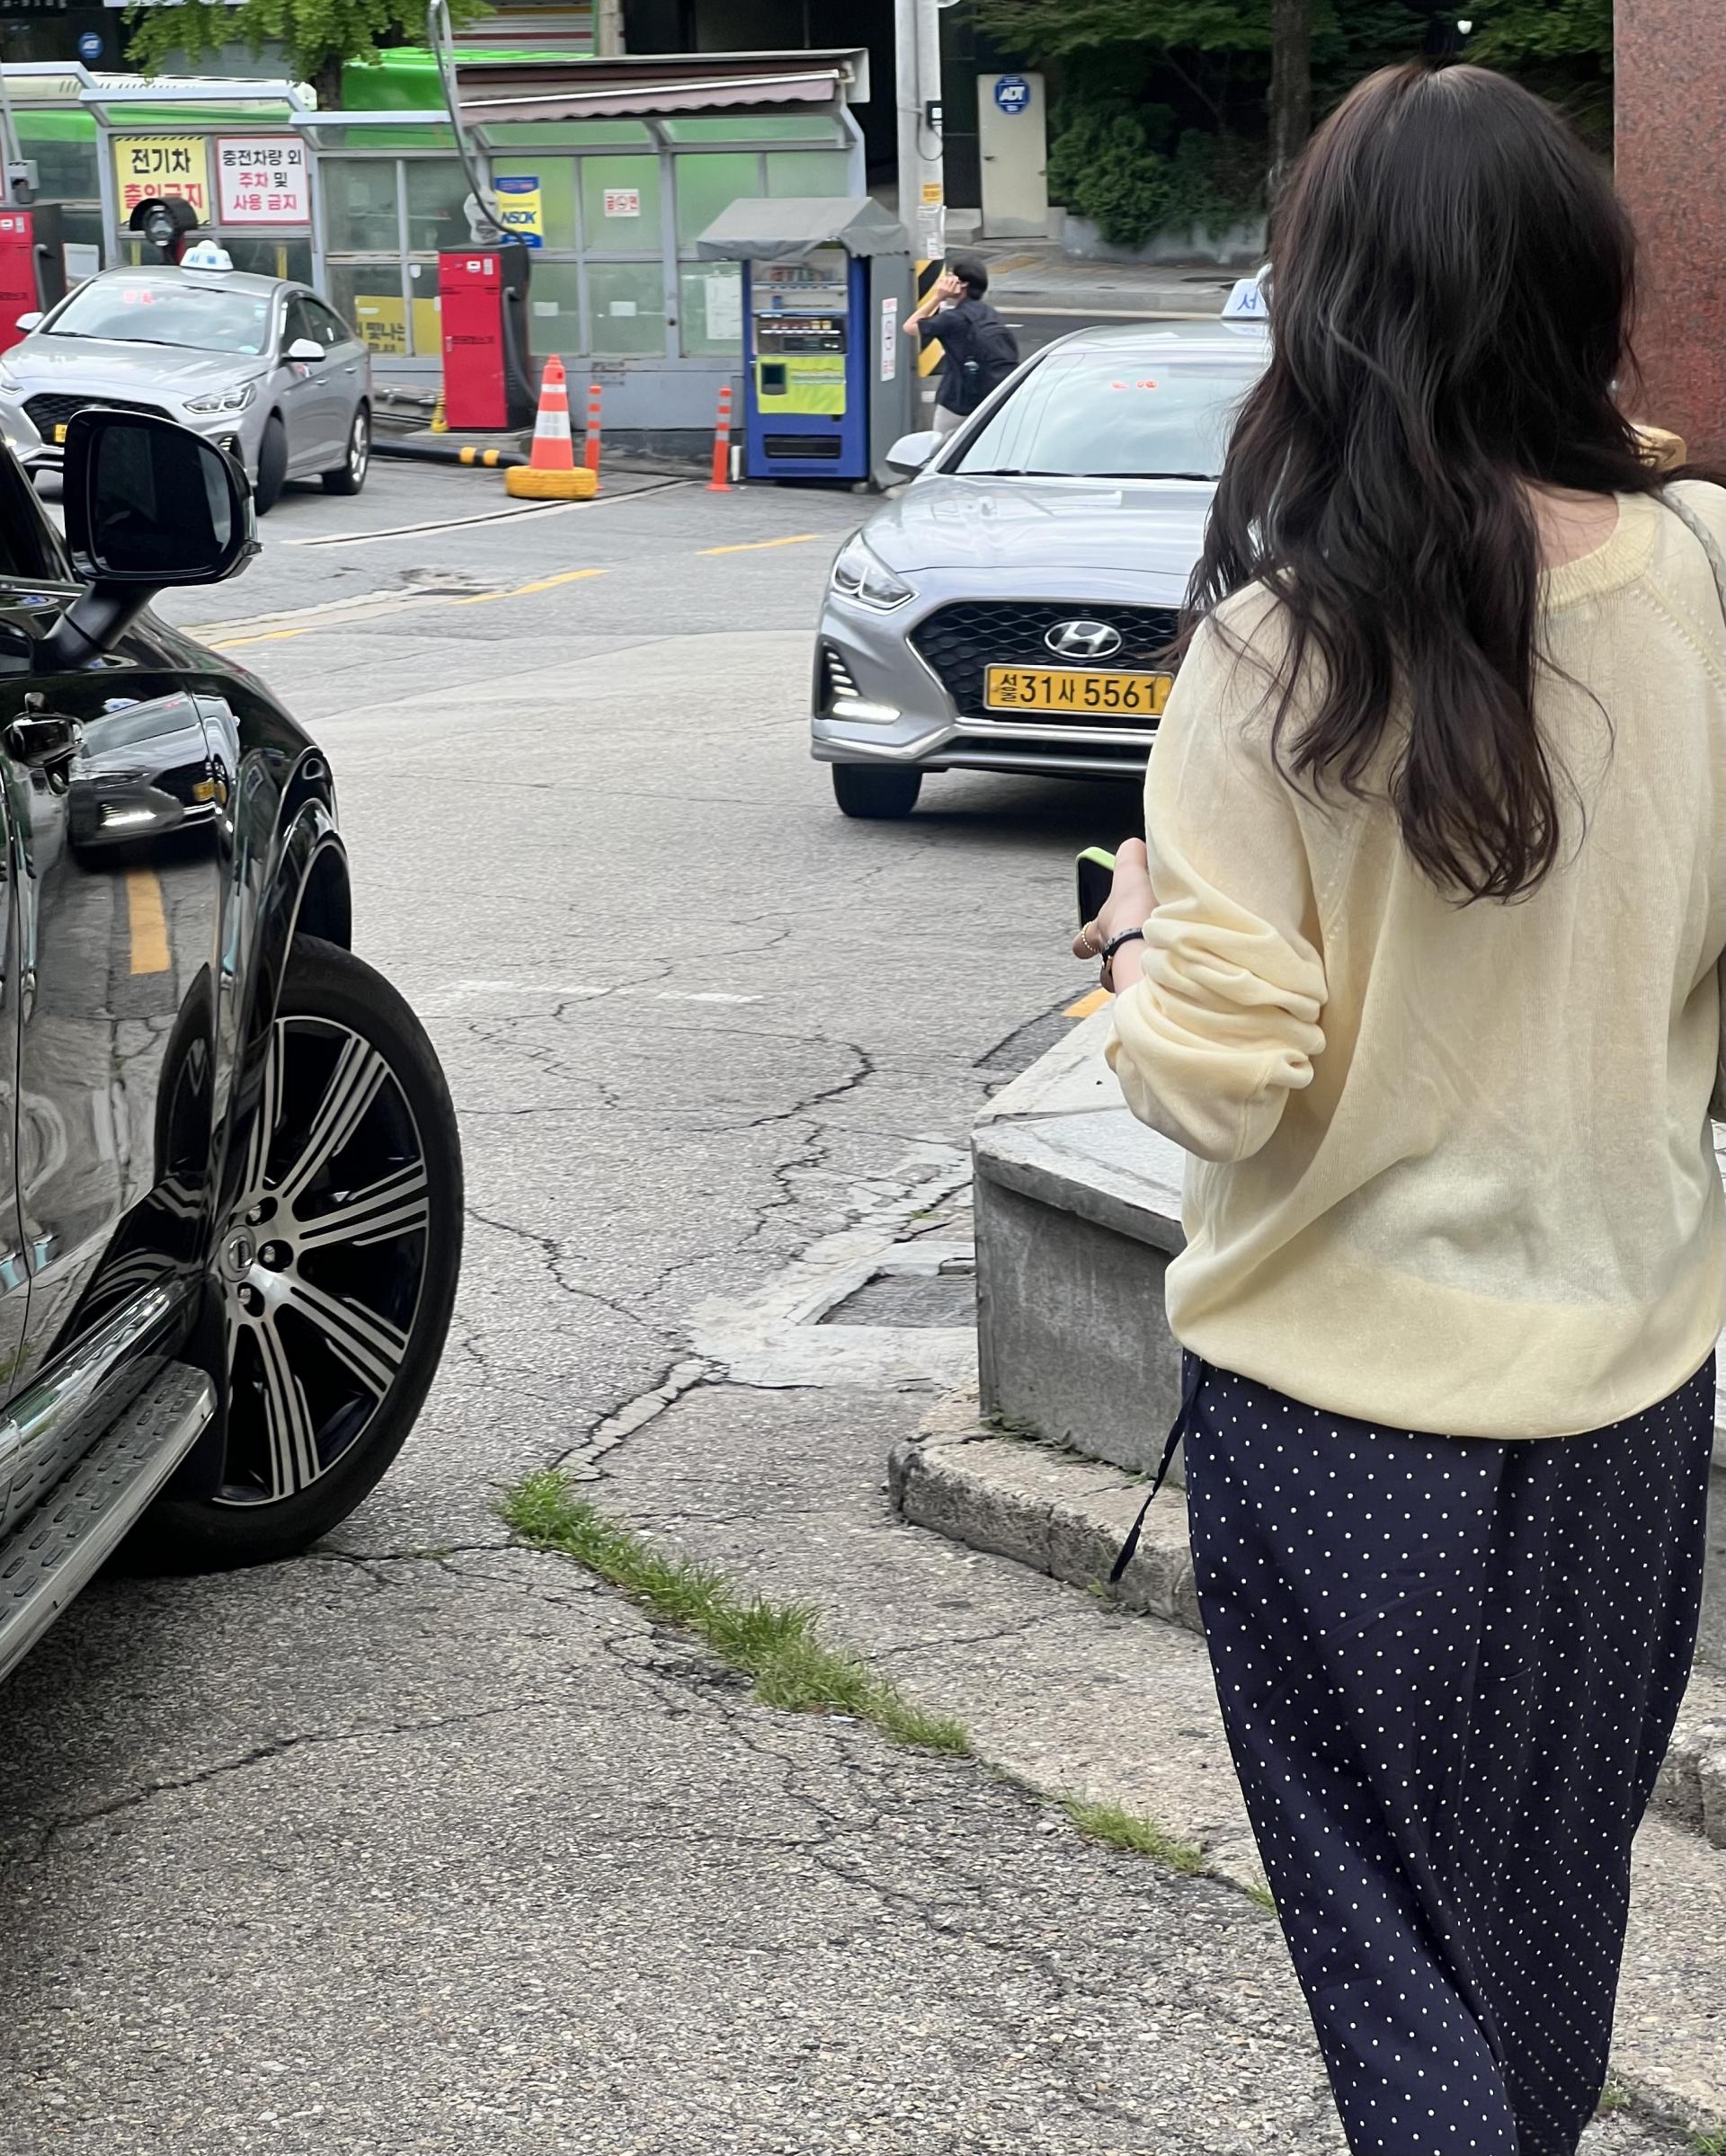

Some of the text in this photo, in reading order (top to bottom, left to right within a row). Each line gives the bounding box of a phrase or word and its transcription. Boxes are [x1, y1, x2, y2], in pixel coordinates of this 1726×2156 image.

[131, 147, 191, 173] 전기차
[223, 149, 302, 166] 충전차량 외
[238, 172, 288, 189] 주차 및
[233, 194, 298, 210] 사용 금지
[1237, 294, 1258, 310] 서
[1001, 673, 1156, 708] 서울 31사 5561
